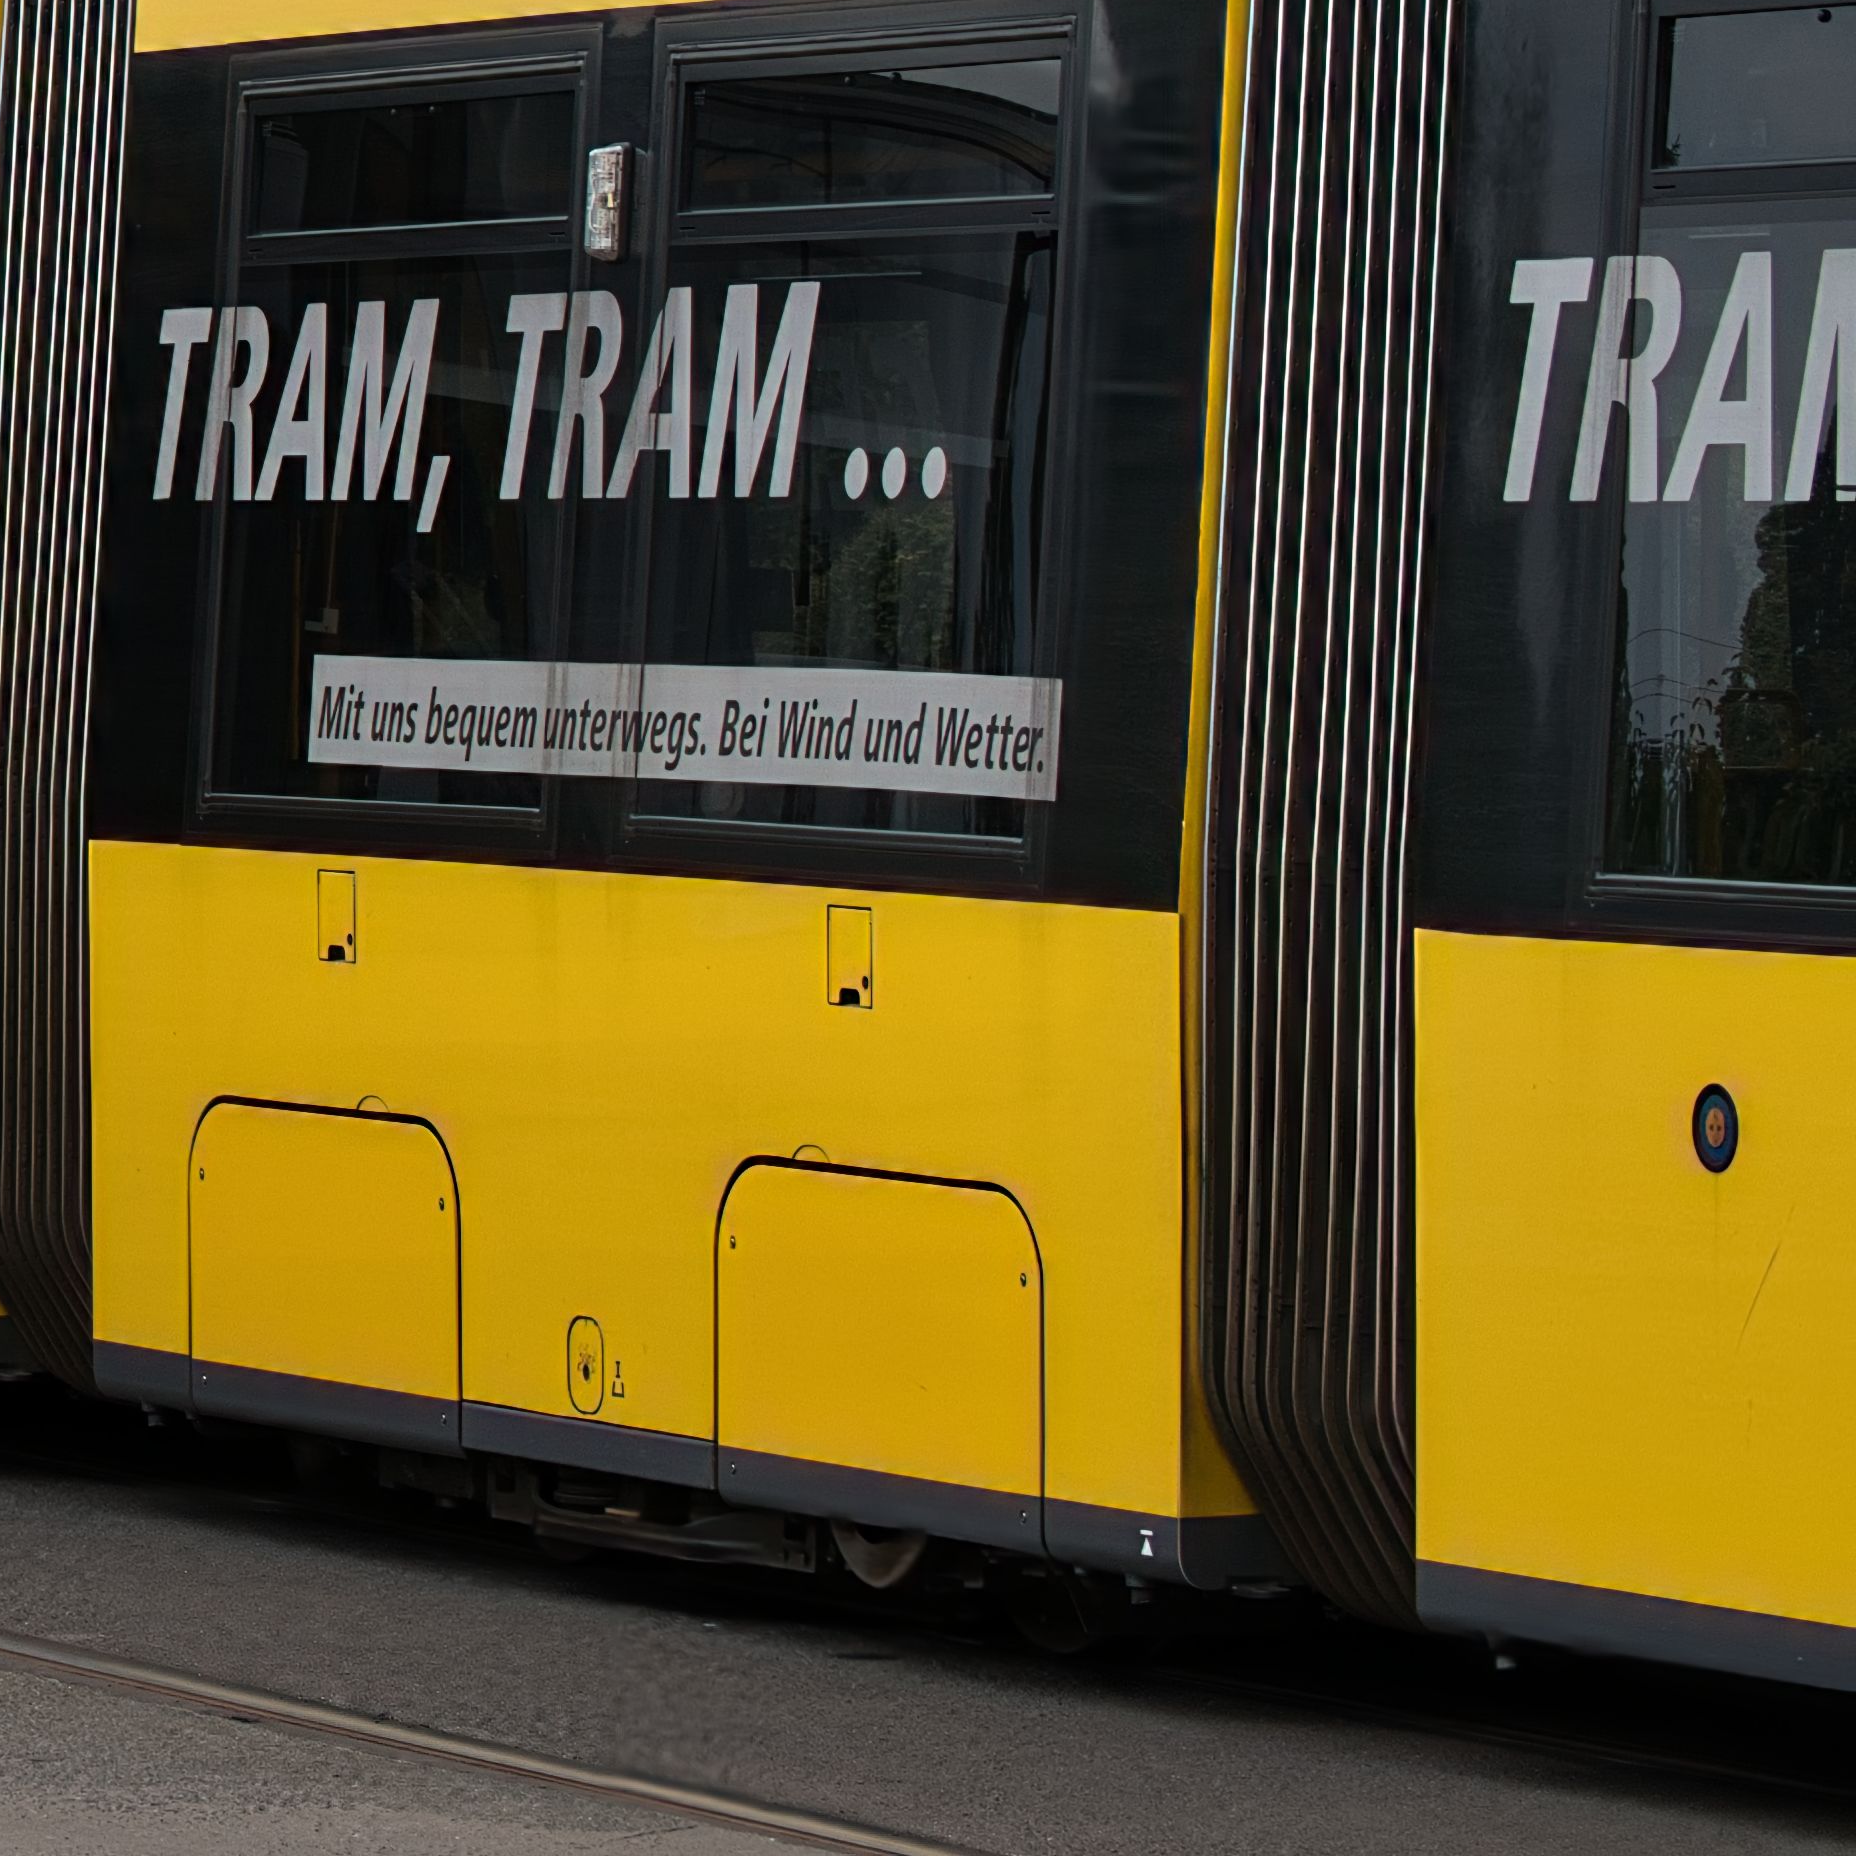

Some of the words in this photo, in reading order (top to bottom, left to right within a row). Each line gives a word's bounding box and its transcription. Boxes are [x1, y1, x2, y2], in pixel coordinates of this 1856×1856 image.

[152, 297, 451, 534] TRAM,
[498, 280, 822, 501] TRAM
[317, 683, 366, 741] Mit
[370, 700, 419, 744] uns
[424, 685, 539, 762] bequem
[543, 698, 707, 771] unterwegs.
[718, 697, 770, 758] Bei
[777, 698, 859, 762] Wind
[863, 701, 928, 766] und
[934, 705, 1045, 774] Wetter.
